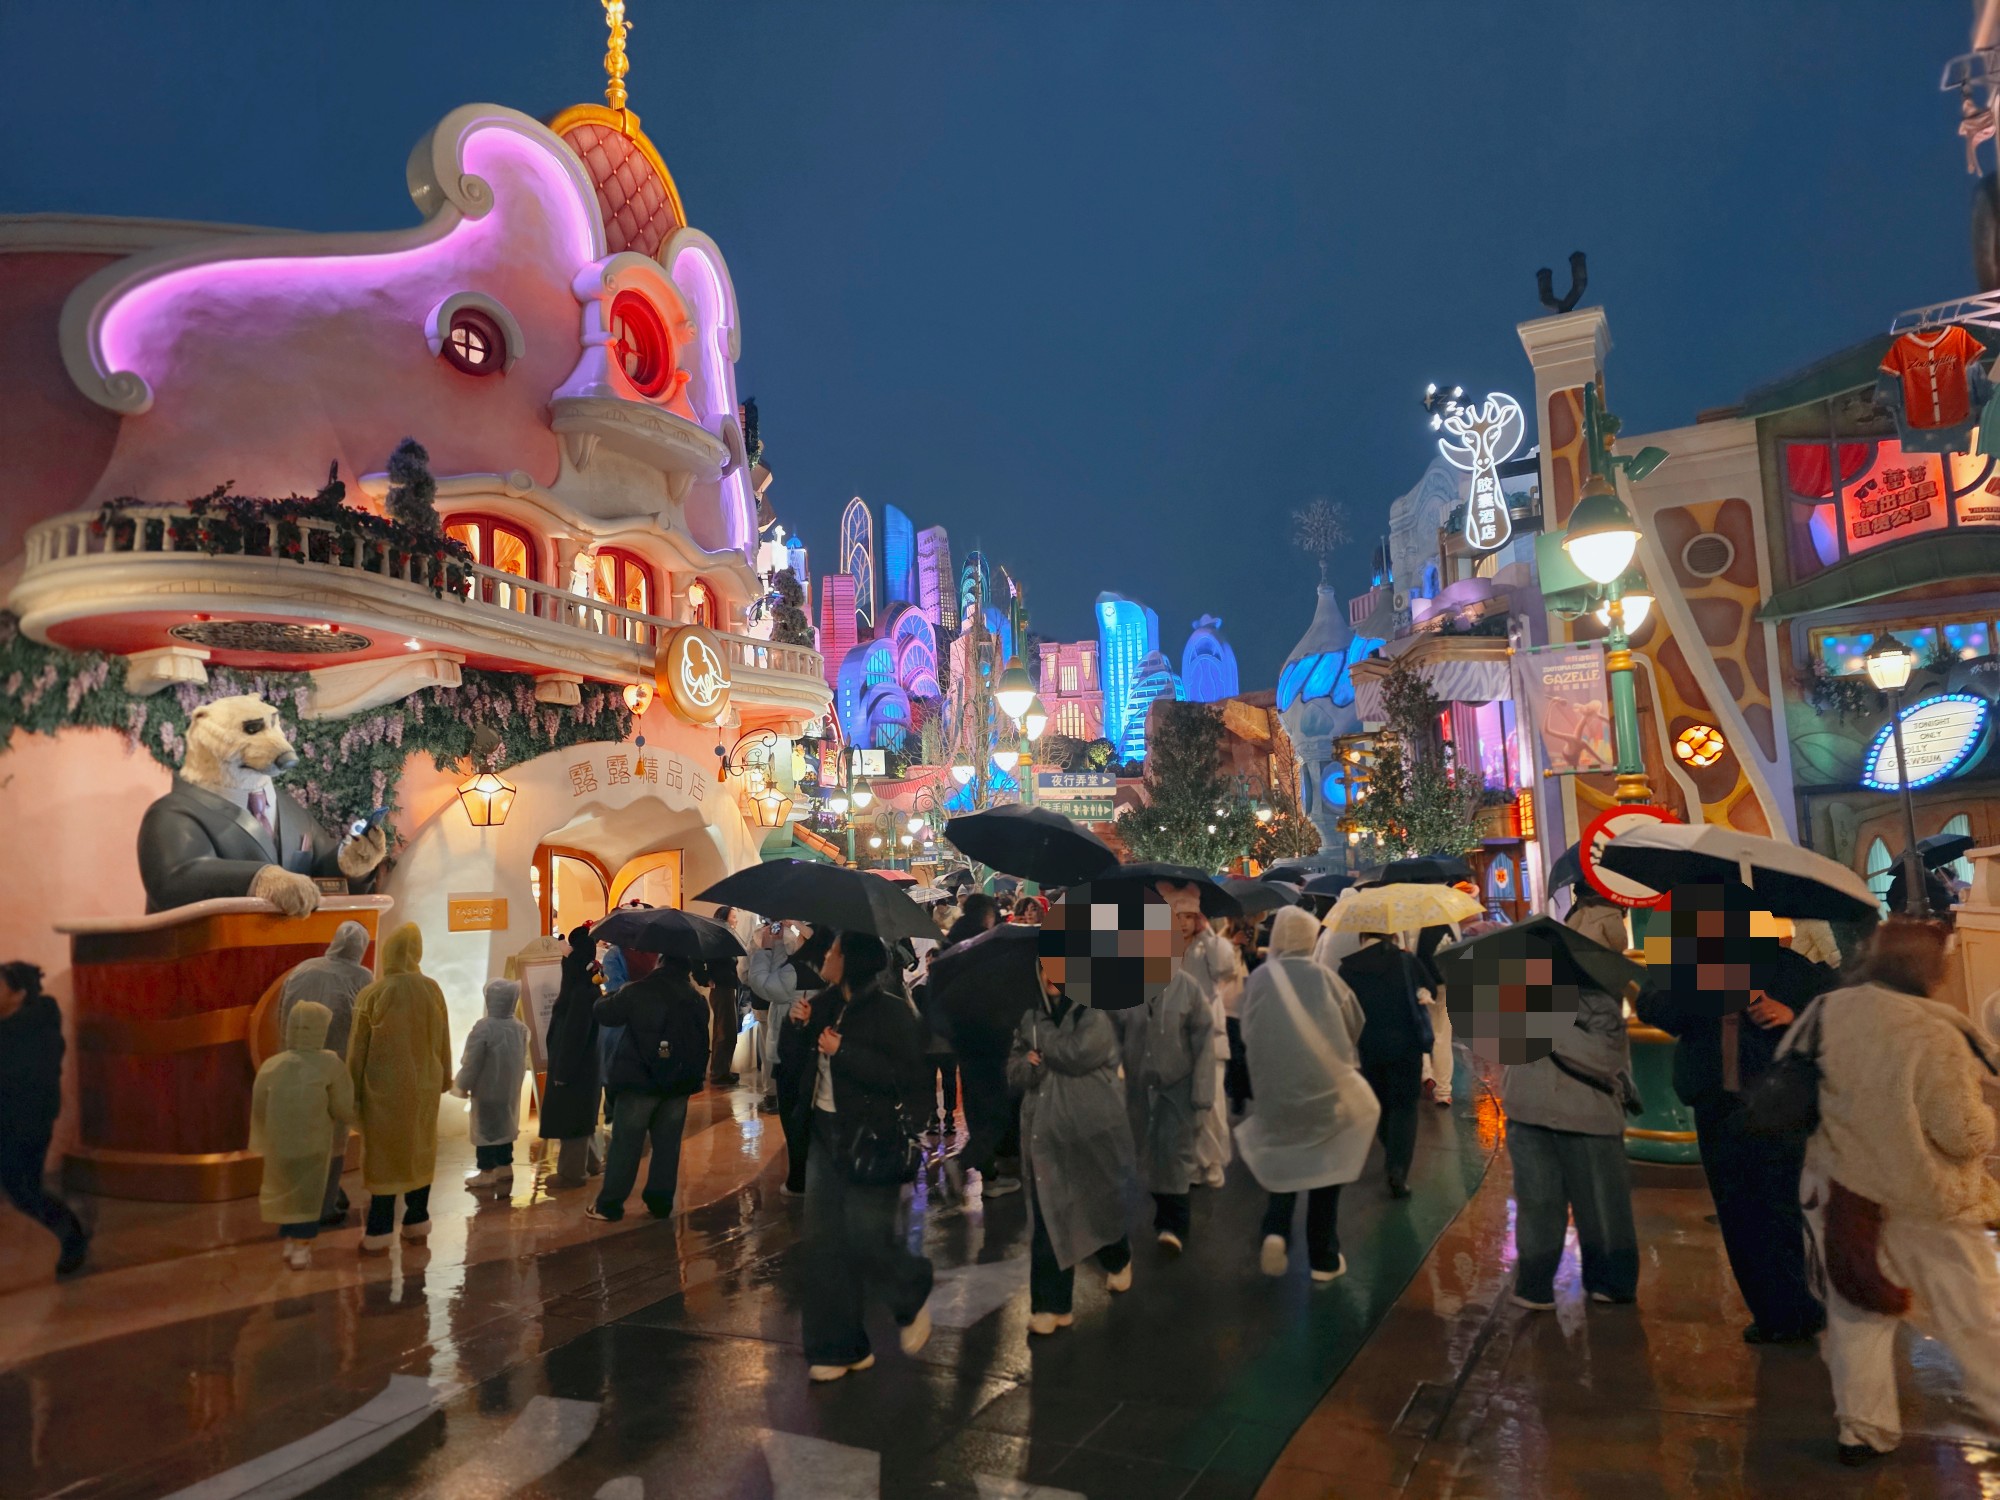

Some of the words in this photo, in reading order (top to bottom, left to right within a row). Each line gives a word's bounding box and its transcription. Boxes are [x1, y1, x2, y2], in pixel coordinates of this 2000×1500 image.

[1476, 477, 1496, 540] 胶囊酒店
[1859, 480, 1938, 519] 演出道具
[1853, 501, 1931, 539] 租赁公司
[1543, 670, 1600, 685] GAZELLE
[1913, 717, 1950, 730] TONIGHT
[1920, 731, 1942, 740] ONLY
[568, 753, 707, 801] 露露精品店
[1051, 774, 1099, 787] 夜行弄堂
